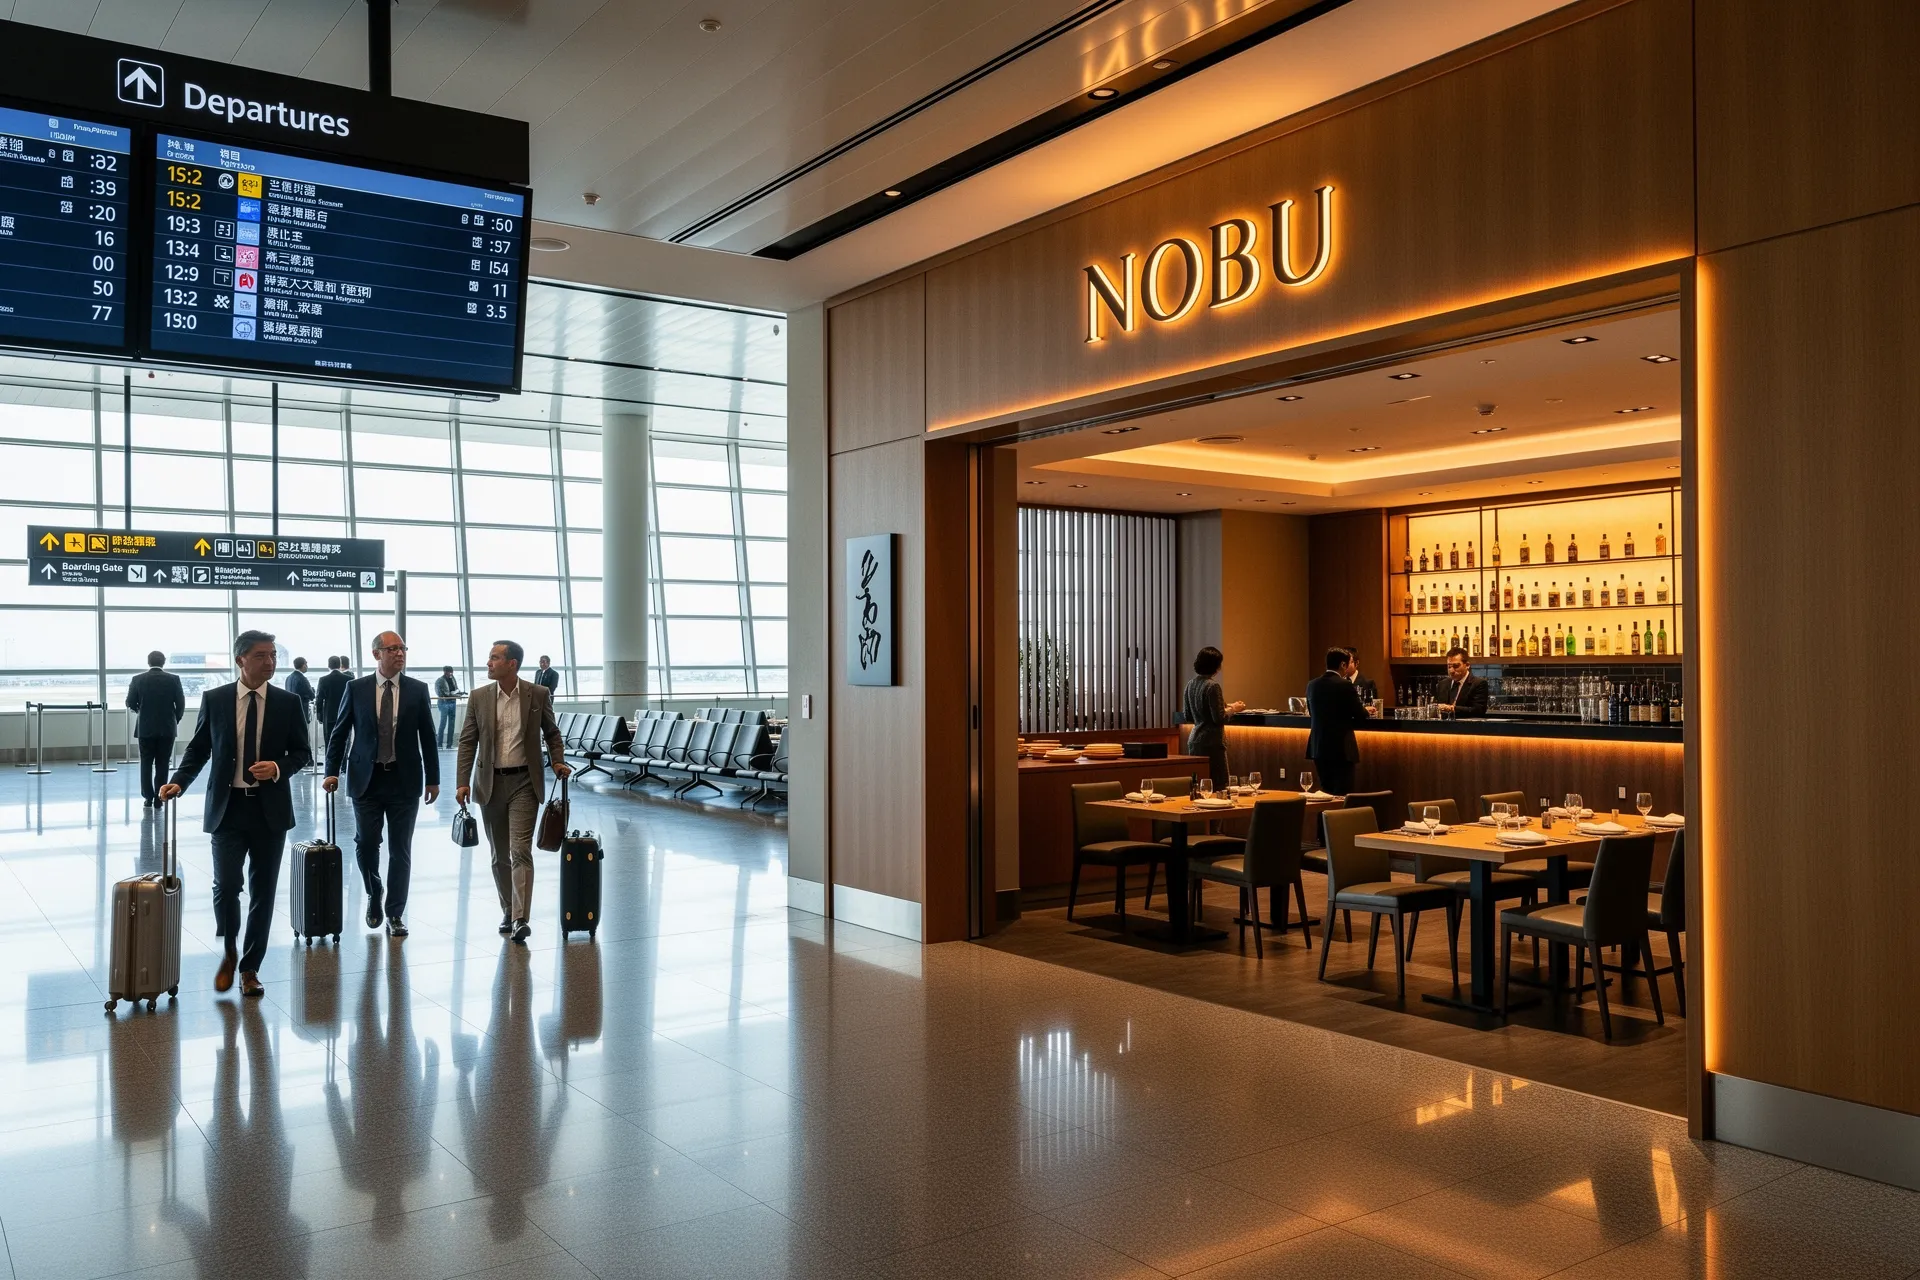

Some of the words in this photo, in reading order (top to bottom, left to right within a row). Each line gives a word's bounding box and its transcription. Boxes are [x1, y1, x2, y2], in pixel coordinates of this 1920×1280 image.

[184, 82, 350, 137] Departures
[167, 165, 203, 186] 15:2
[167, 190, 202, 210] 15:2
[89, 204, 116, 222] :20
[166, 215, 201, 234] 19:3
[95, 230, 115, 247] 16
[165, 239, 200, 258] 13:4
[92, 255, 115, 272] 00
[1082, 185, 1335, 343] NOBU
[164, 264, 199, 282] 12:9
[92, 280, 114, 297] 50
[164, 288, 198, 307] 13:2
[91, 304, 113, 321] 77
[486, 304, 507, 319] 3.5
[62, 562, 101, 573] Boarding
[102, 563, 124, 572] Gate
